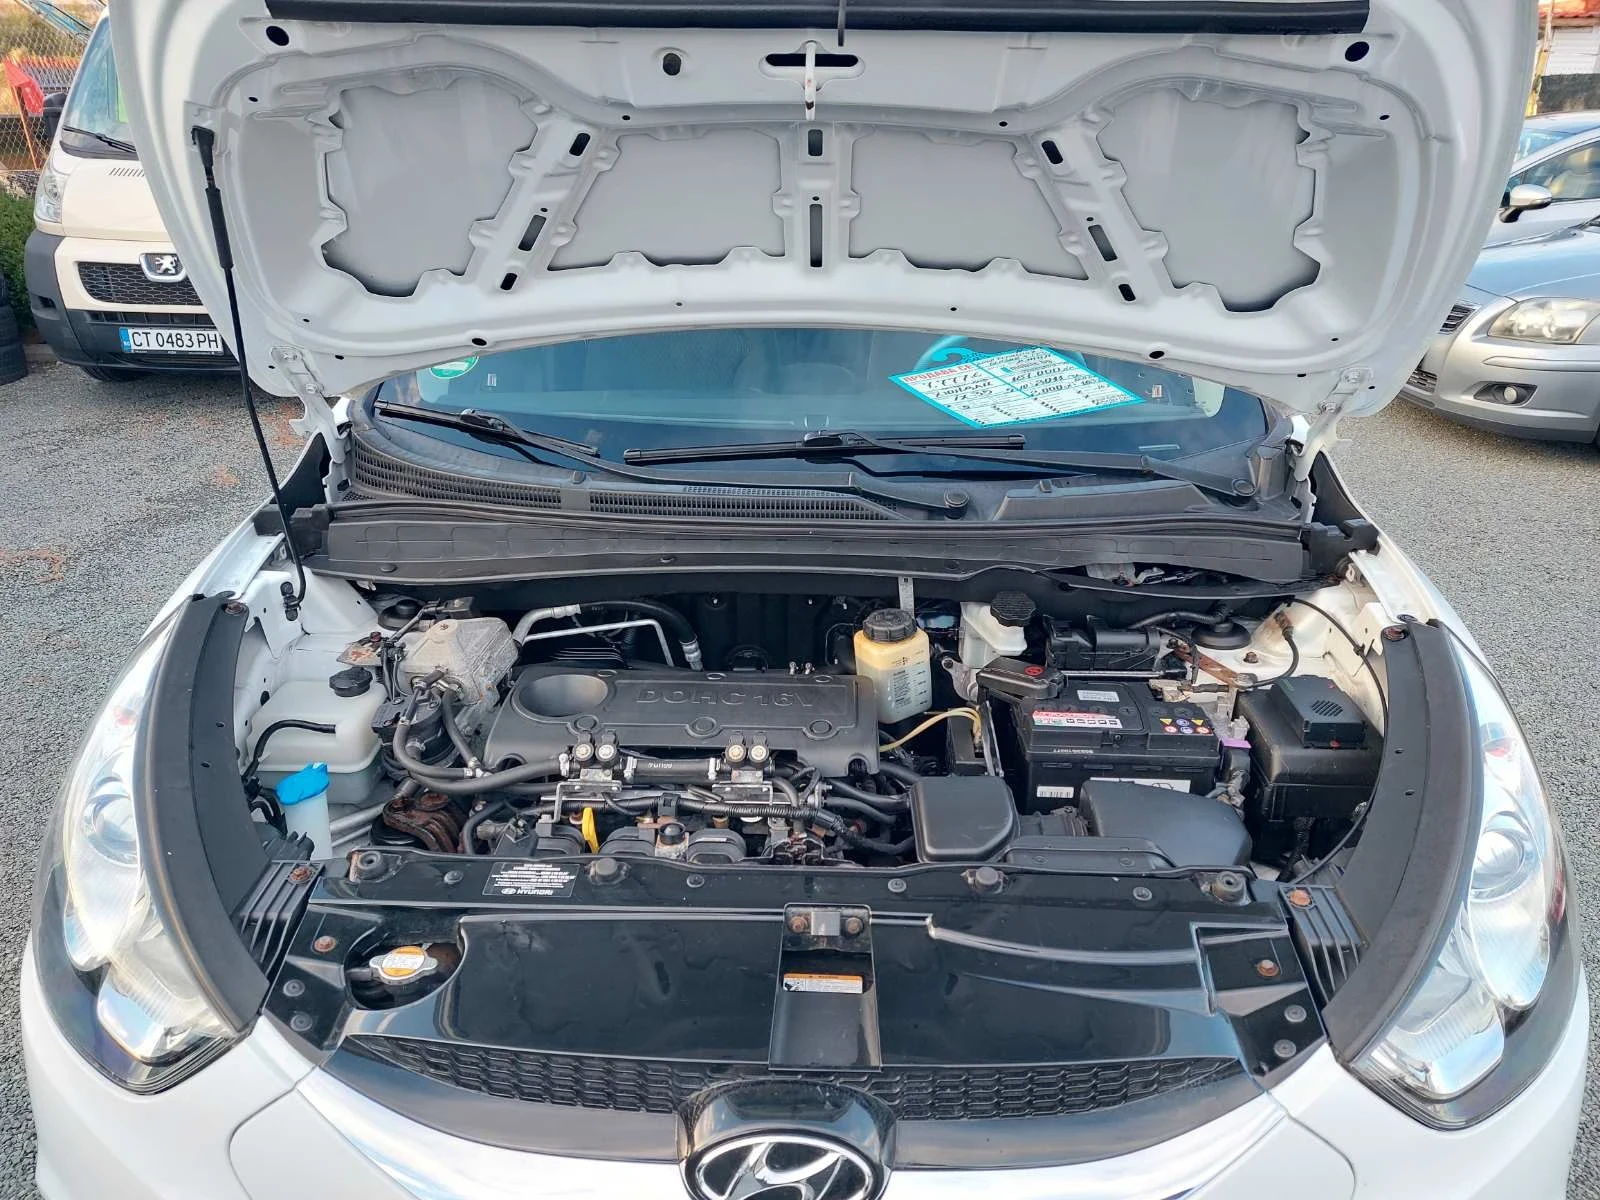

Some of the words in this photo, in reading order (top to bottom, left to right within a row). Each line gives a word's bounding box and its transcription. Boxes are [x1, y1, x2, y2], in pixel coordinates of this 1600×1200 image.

[155, 332, 194, 348] 0483
[636, 690, 746, 706] DOHC
[754, 692, 815, 707] 16V
